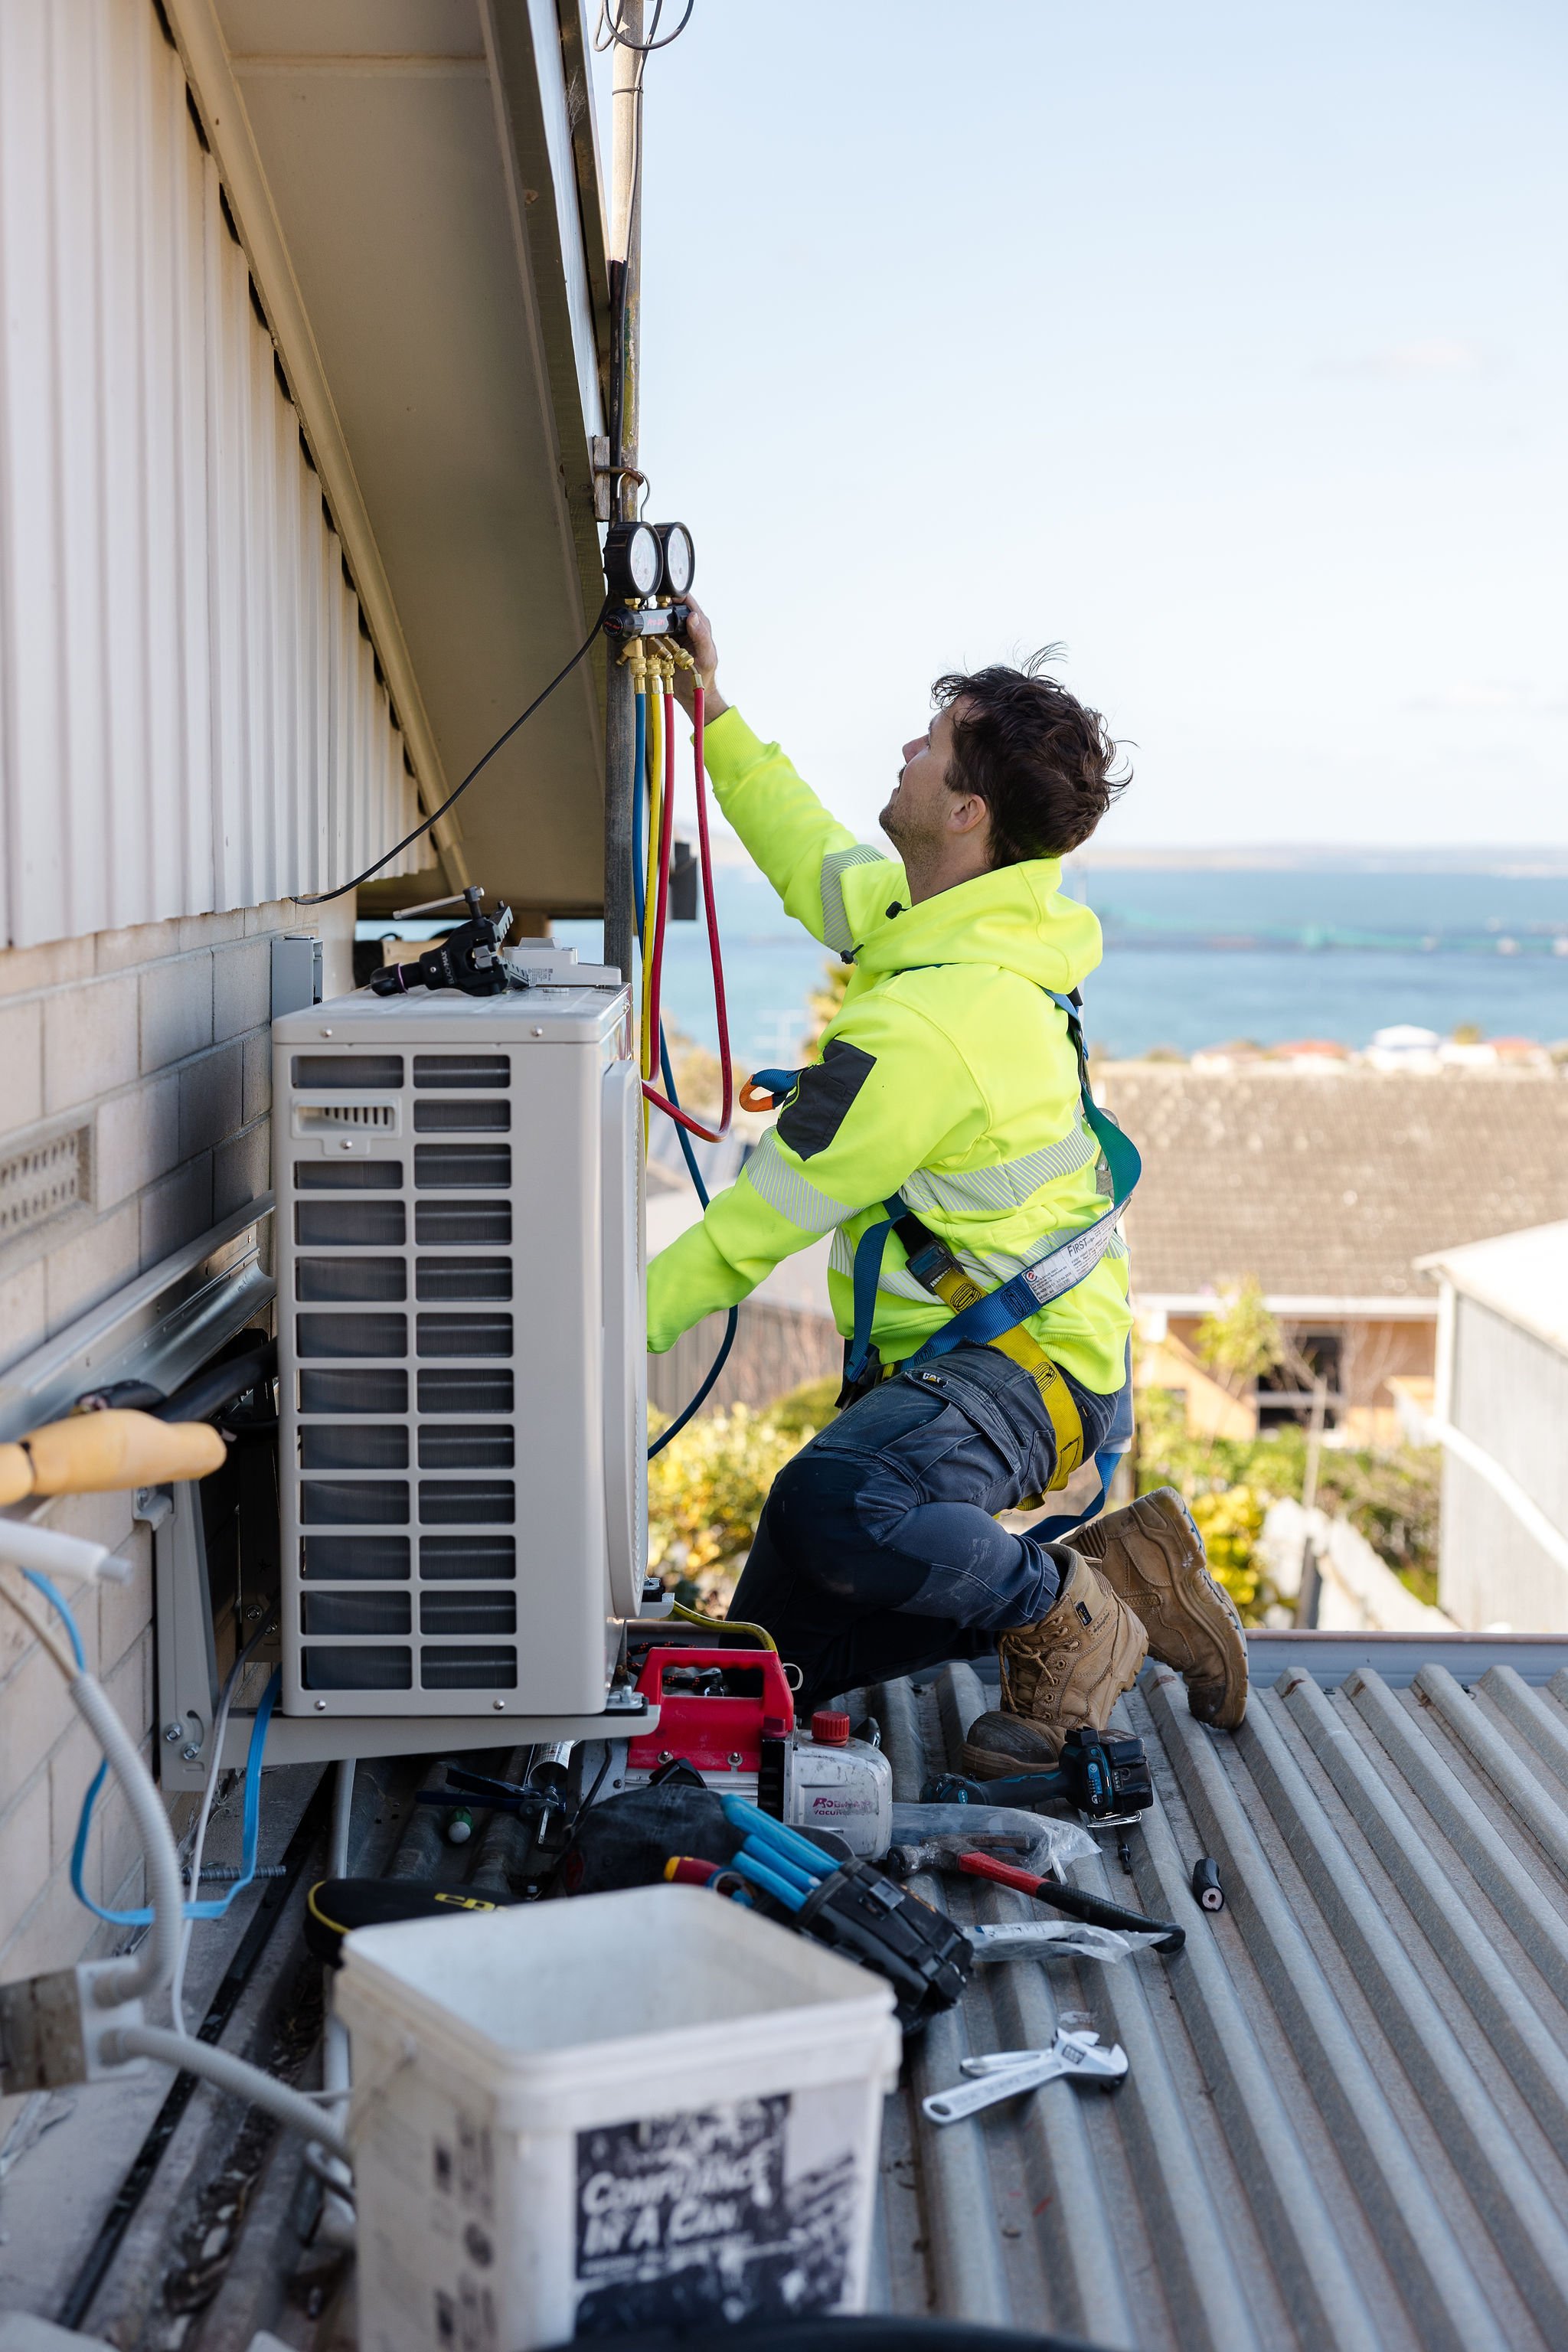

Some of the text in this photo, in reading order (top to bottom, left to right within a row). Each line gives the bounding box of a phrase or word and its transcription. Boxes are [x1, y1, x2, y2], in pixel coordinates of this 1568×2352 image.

[1067, 1238, 1087, 1257] FIRST
[923, 1372, 942, 1383] CAT
[584, 2198, 737, 2256] IN A CAN
